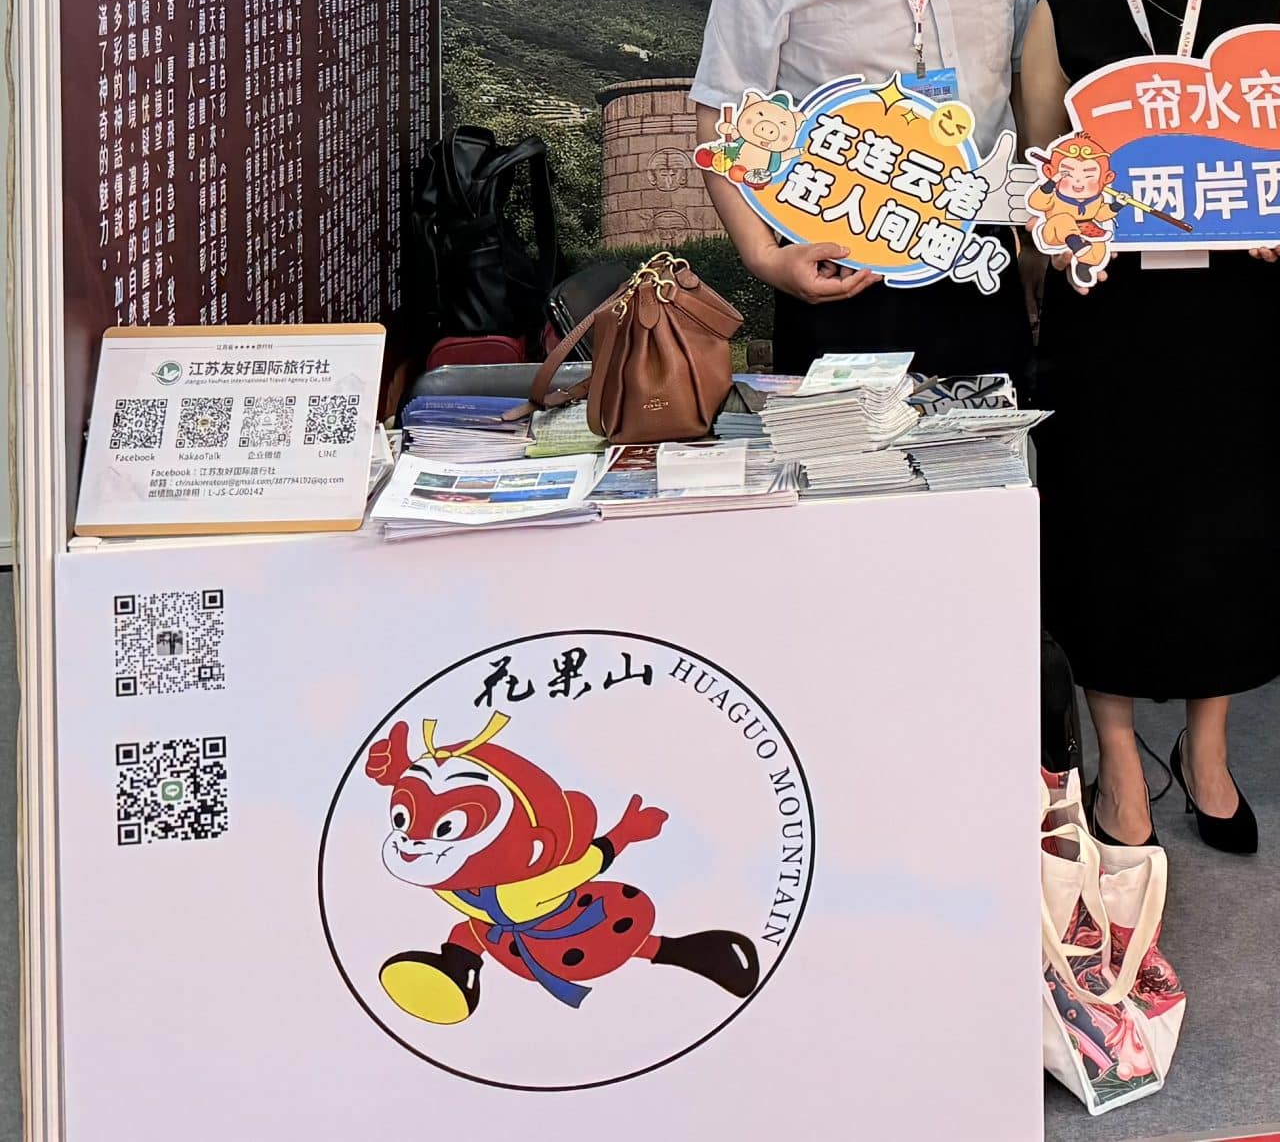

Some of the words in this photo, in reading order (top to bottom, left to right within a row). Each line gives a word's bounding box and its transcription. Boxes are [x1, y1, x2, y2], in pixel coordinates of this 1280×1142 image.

[807, 112, 990, 221] 在连云港
[775, 161, 1007, 292] 赶人间烟火
[188, 359, 331, 376] 江苏友好国际旅行社
[115, 453, 155, 462] Facebook
[318, 450, 337, 458] LINE
[474, 646, 653, 708] 花果山
[669, 656, 779, 761] HUAGUO
[760, 766, 804, 948] MOUNTAIN
